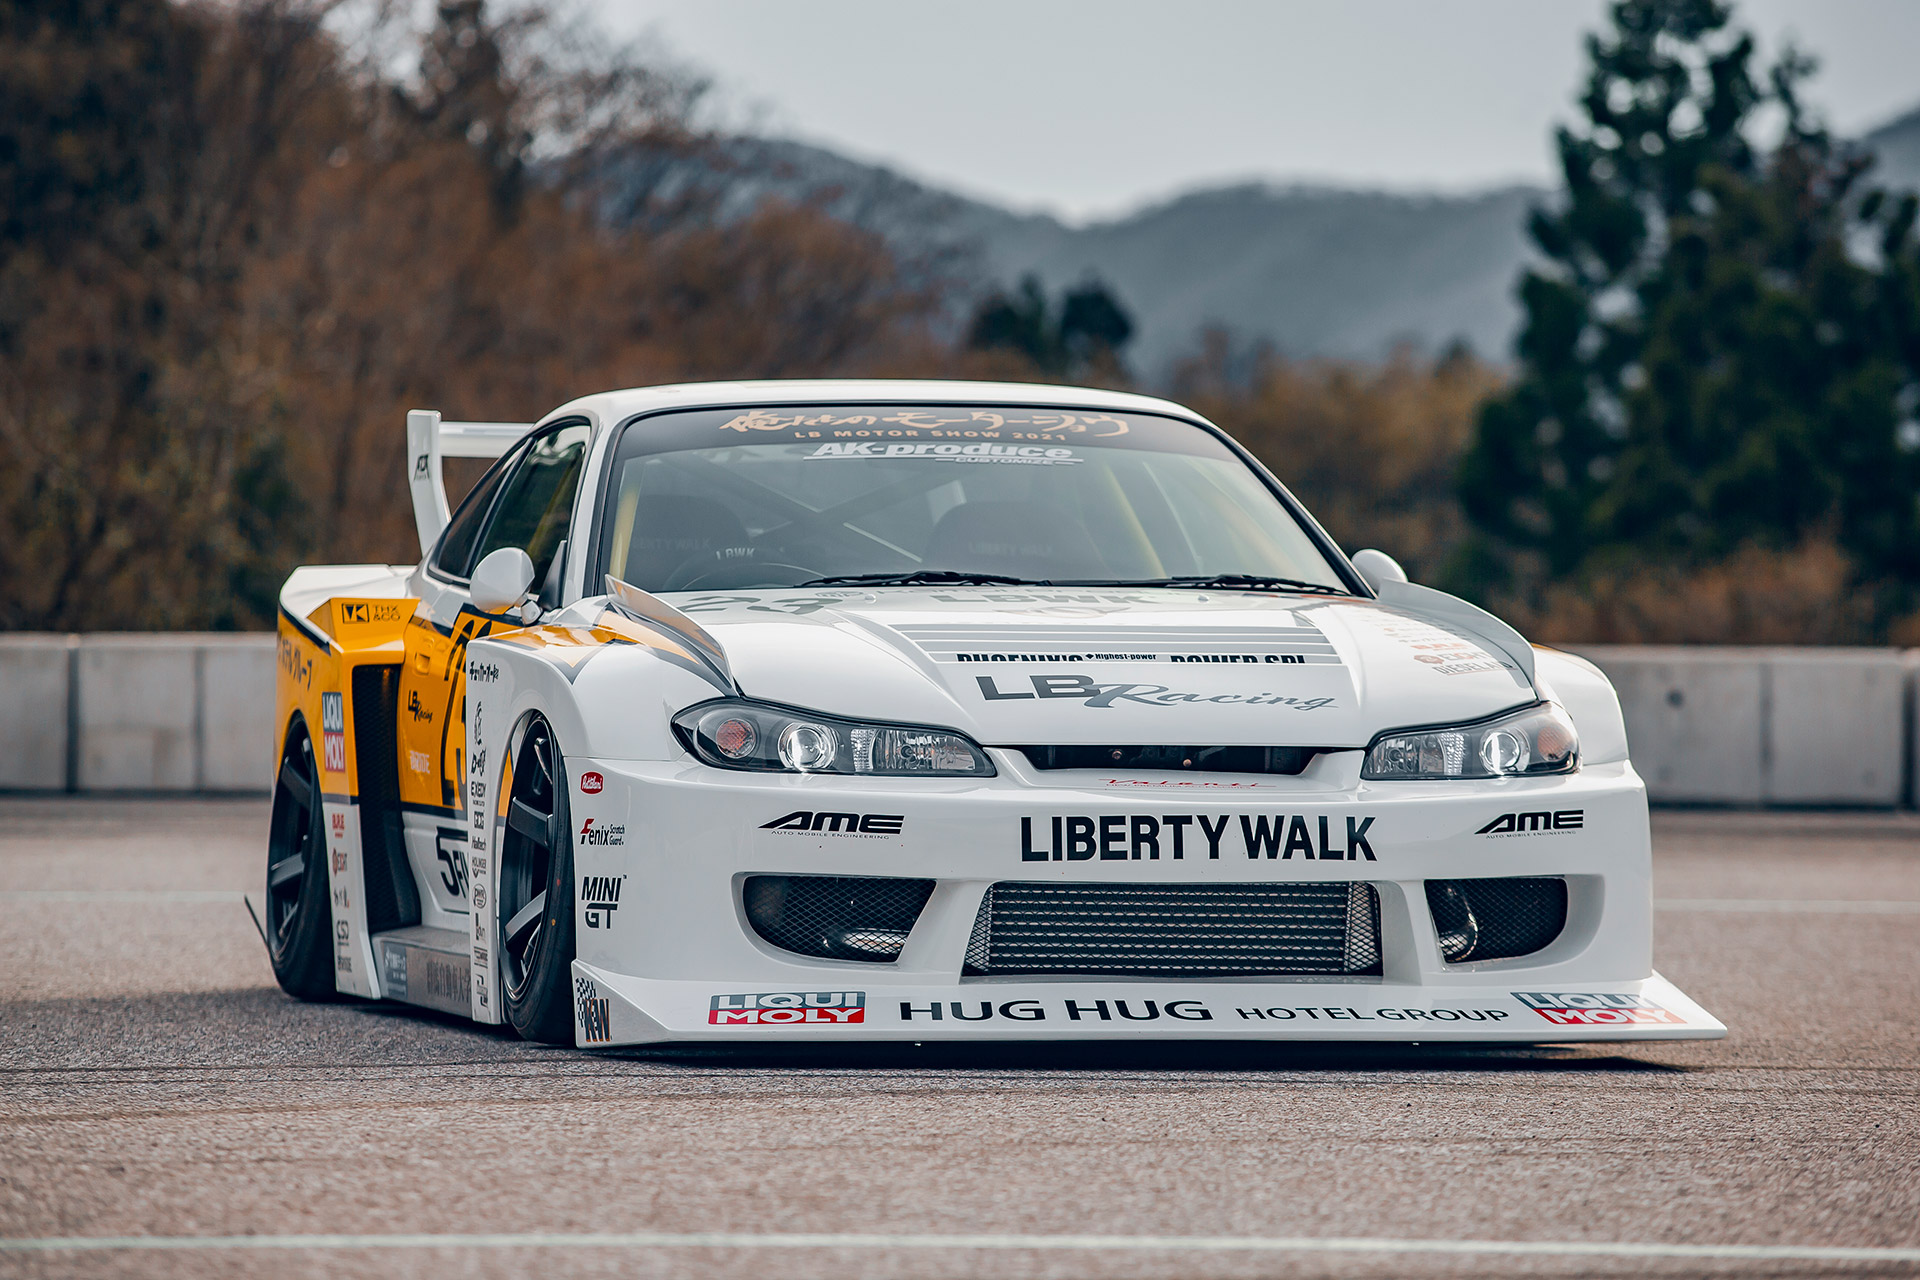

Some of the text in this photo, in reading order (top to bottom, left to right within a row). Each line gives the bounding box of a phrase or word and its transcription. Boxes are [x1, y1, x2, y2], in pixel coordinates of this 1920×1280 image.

[931, 430, 1000, 438] SHOW
[1012, 432, 1066, 440] 2021
[812, 442, 1073, 459] AK-produce
[975, 675, 1339, 711] LB Racing
[323, 694, 343, 731] LIQUI
[325, 735, 345, 770] MOLY
[580, 818, 610, 846] Fenix
[609, 824, 625, 834] Scratch
[758, 811, 904, 834] AME
[1474, 810, 1584, 834] AME
[1020, 815, 1377, 862] LIBERTY WALK
[581, 876, 622, 902] MINI
[585, 903, 618, 929] GT
[718, 992, 858, 1009] LIQUI
[900, 1001, 1046, 1021] HUG
[1063, 1000, 1214, 1021] HUG
[1519, 992, 1664, 1009] LIQUI
[583, 999, 611, 1042] KW
[712, 1009, 862, 1023] MOLY
[1540, 1009, 1680, 1024] MOLY
